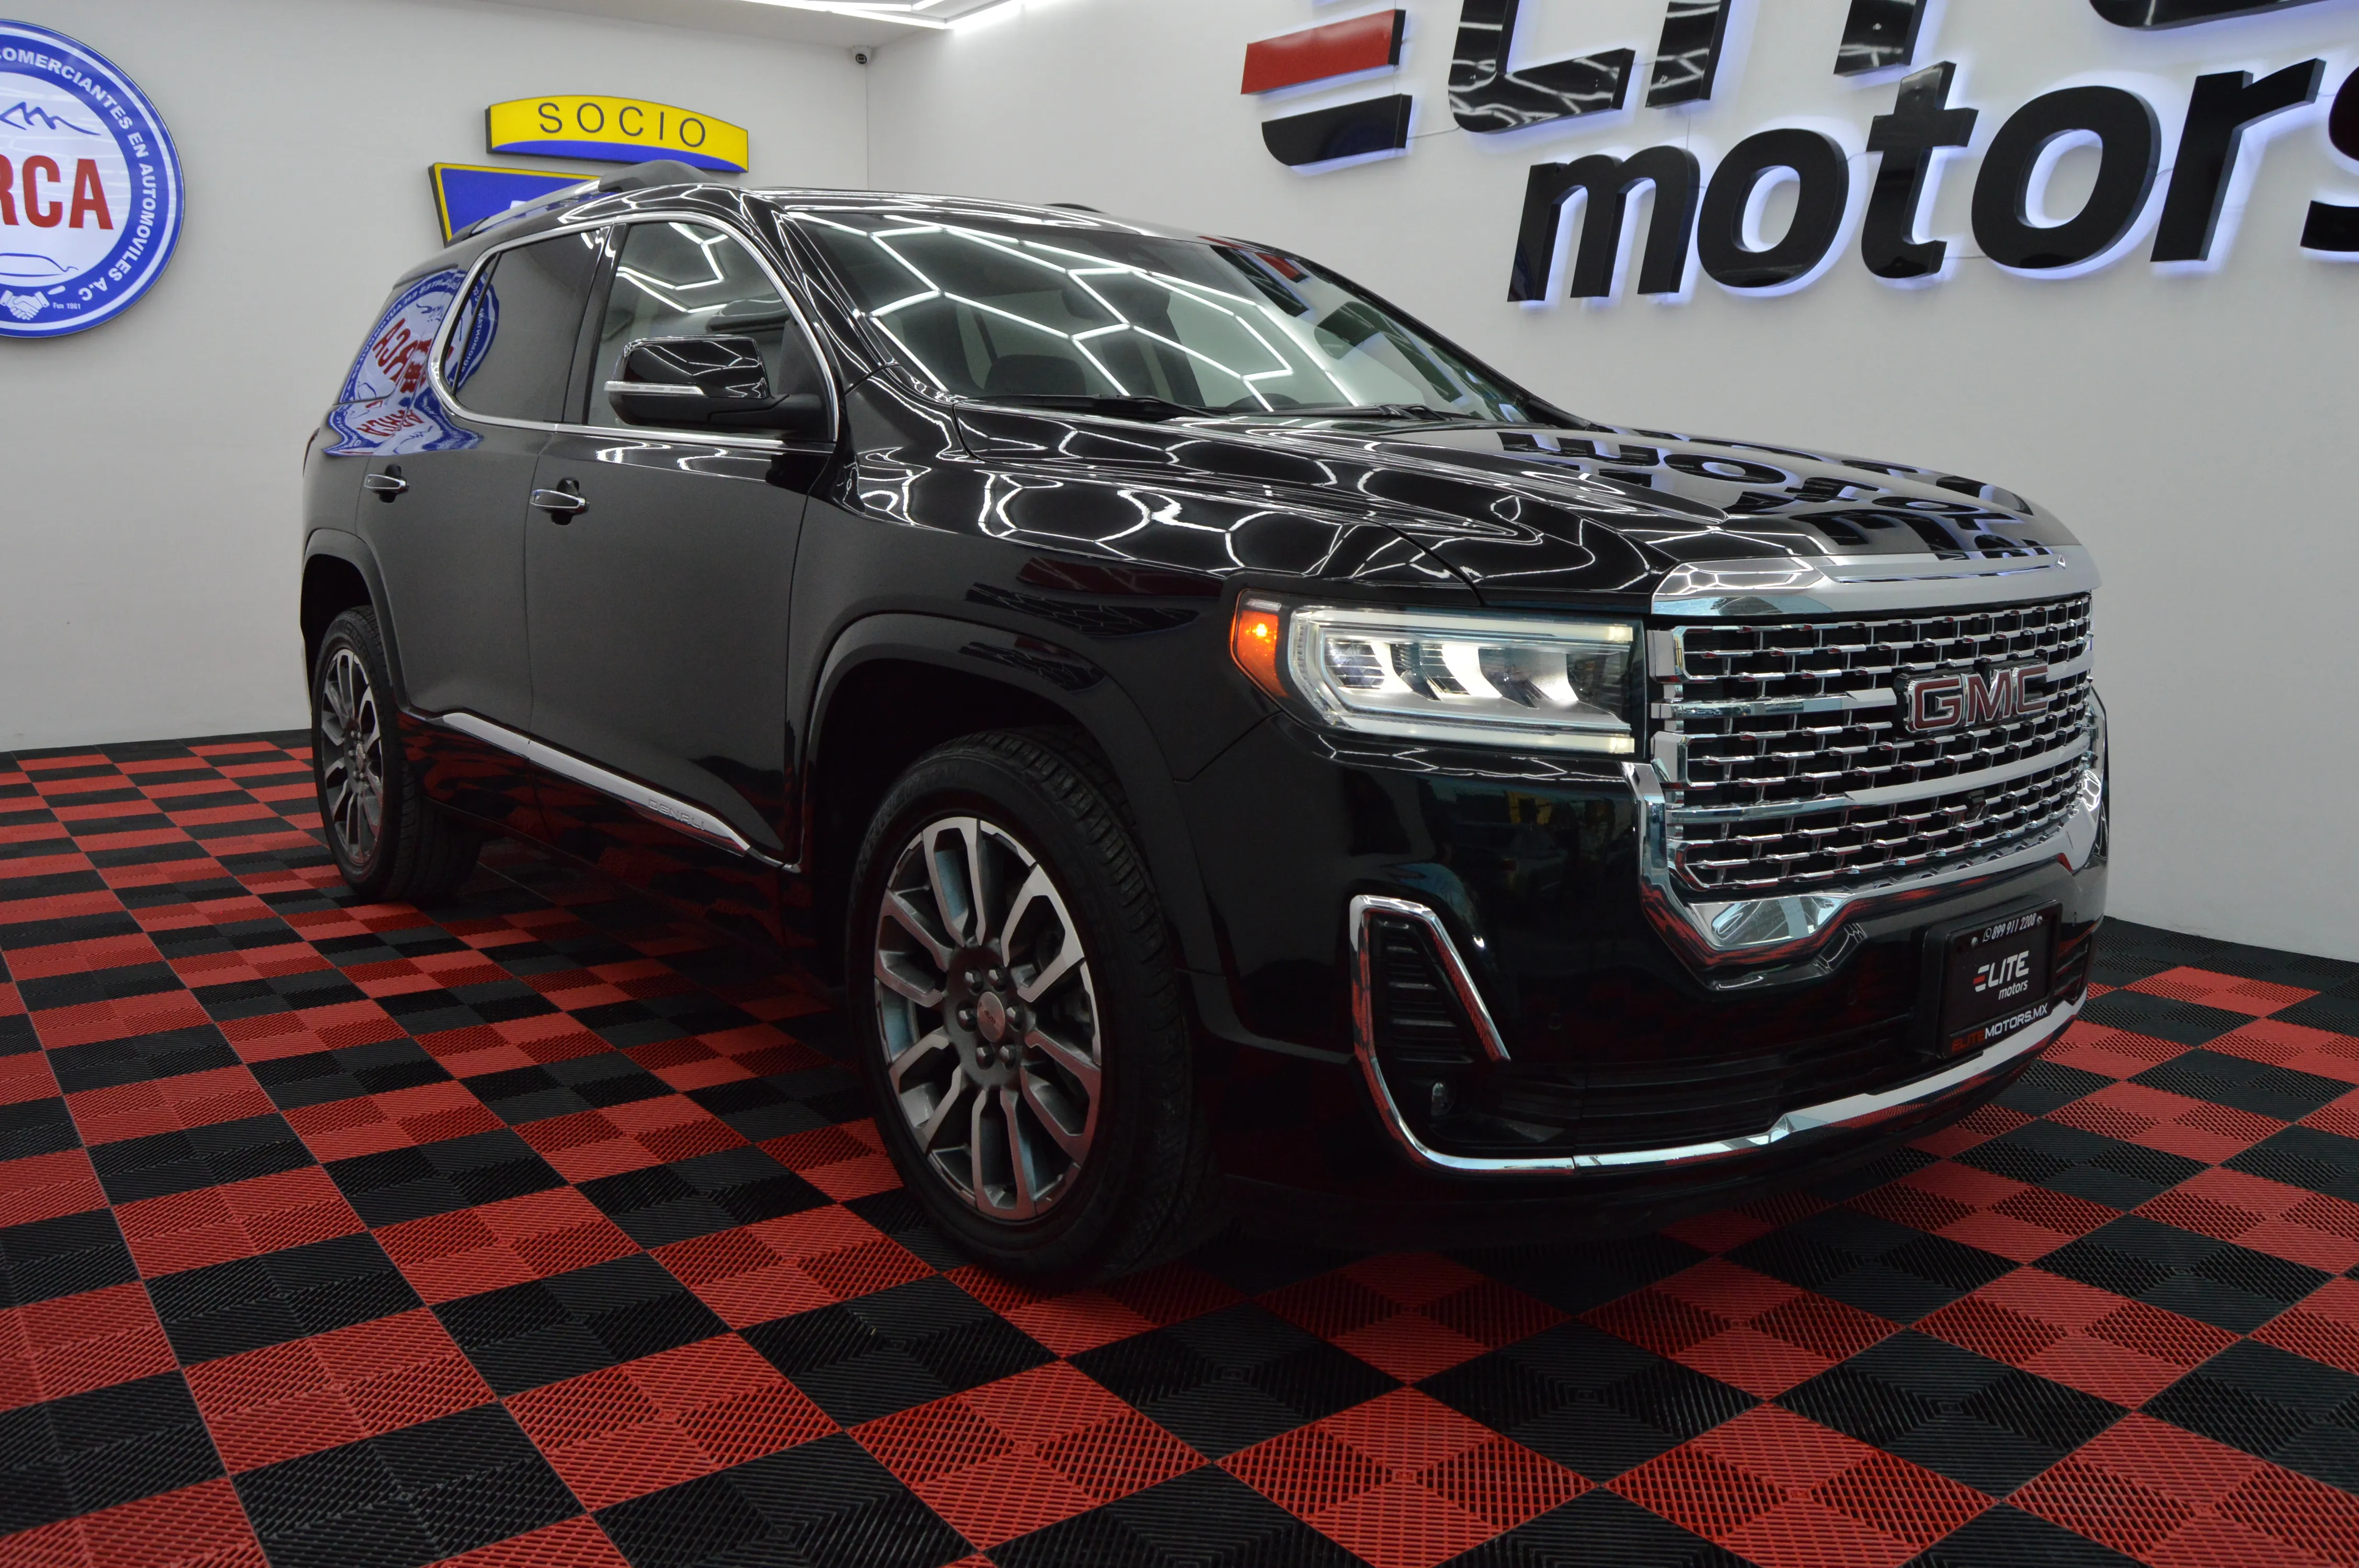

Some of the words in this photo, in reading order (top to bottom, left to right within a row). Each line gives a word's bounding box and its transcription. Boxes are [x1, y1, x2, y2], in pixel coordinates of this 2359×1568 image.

[0, 47, 133, 130] OMERCIANTES
[128, 132, 149, 158] EN
[537, 102, 706, 148] SOCIO
[108, 163, 156, 281] AUTOMOVILES
[1904, 662, 2048, 733] GMC
[648, 799, 705, 831] DENALI
[1991, 923, 2006, 940] 899
[2006, 918, 2019, 935] 911
[2019, 913, 2036, 930] 2208
[1973, 950, 2029, 992] ELITE
[1998, 979, 2028, 1000] motors
